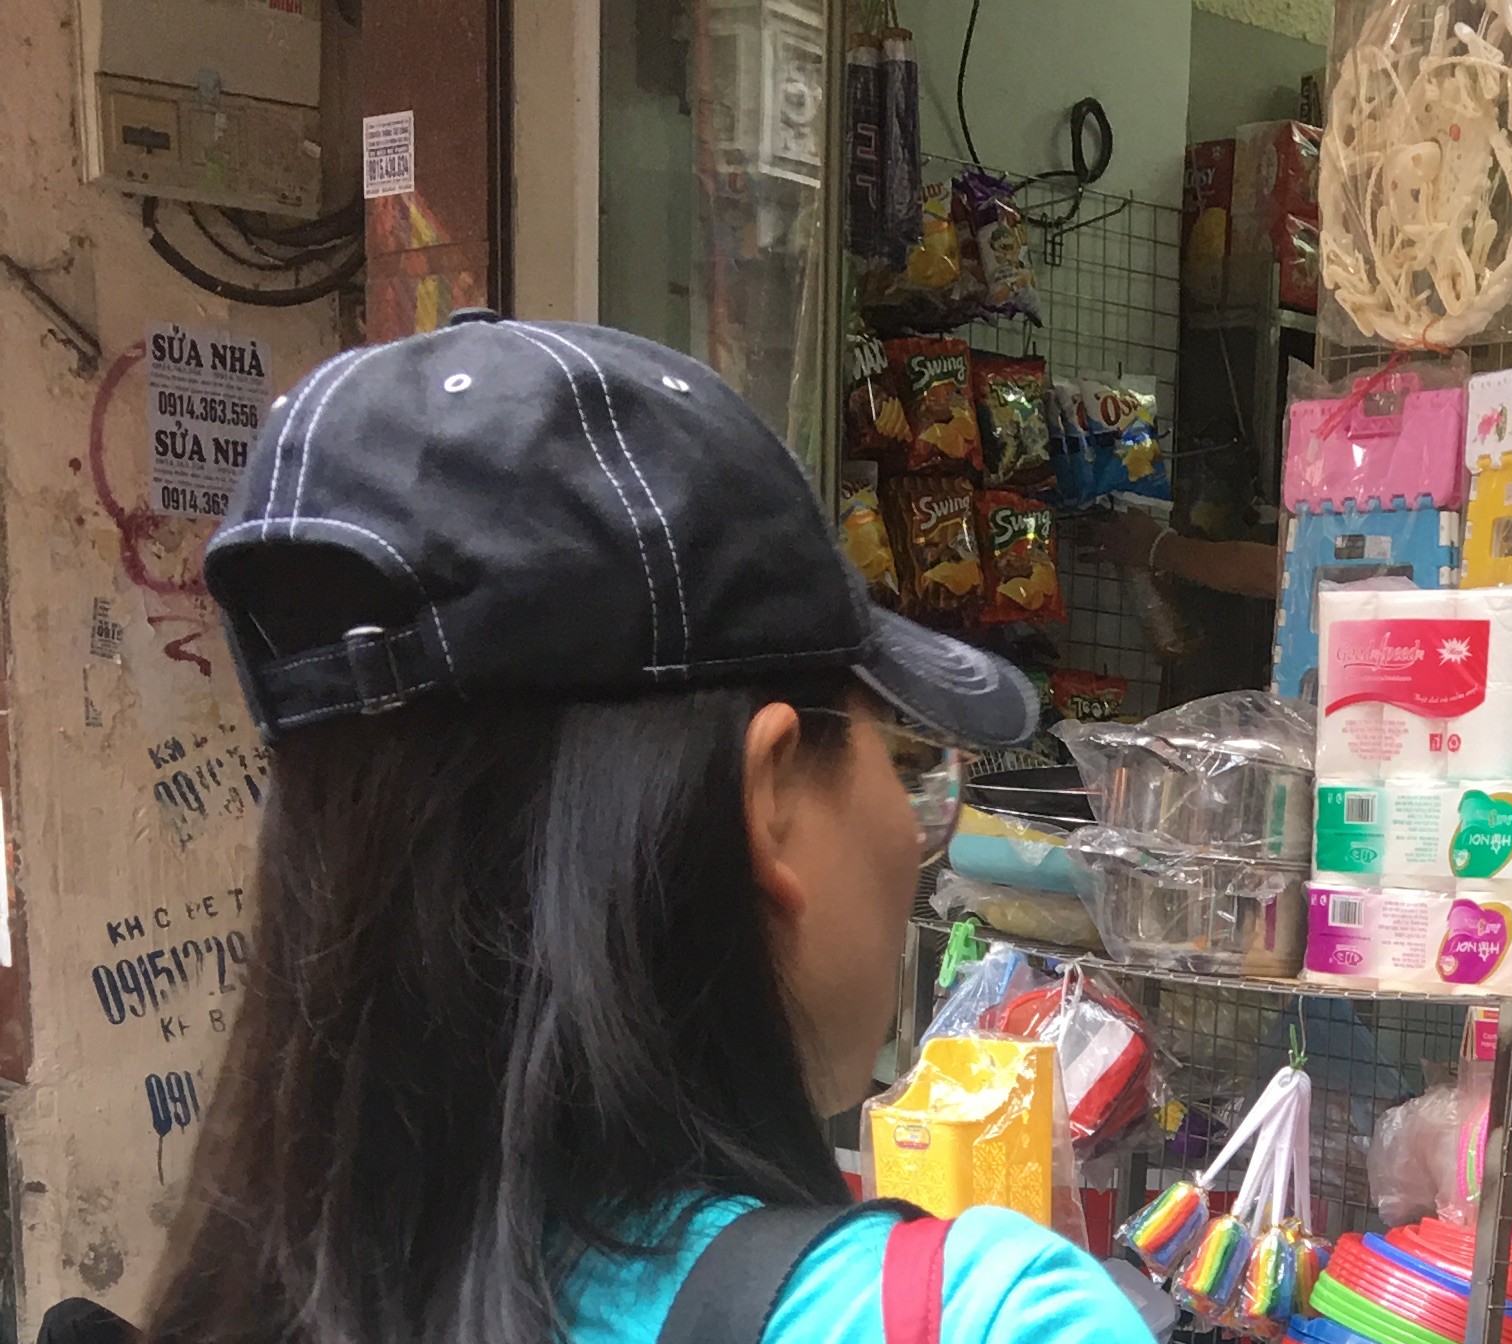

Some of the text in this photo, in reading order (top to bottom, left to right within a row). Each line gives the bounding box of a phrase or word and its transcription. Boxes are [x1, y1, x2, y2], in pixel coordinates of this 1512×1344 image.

[911, 355, 966, 391] Swing
[157, 390, 259, 430] 0914.363.556
[154, 421, 248, 468] SỬA NH
[161, 485, 229, 517] 0914.363
[918, 495, 971, 531] Swing
